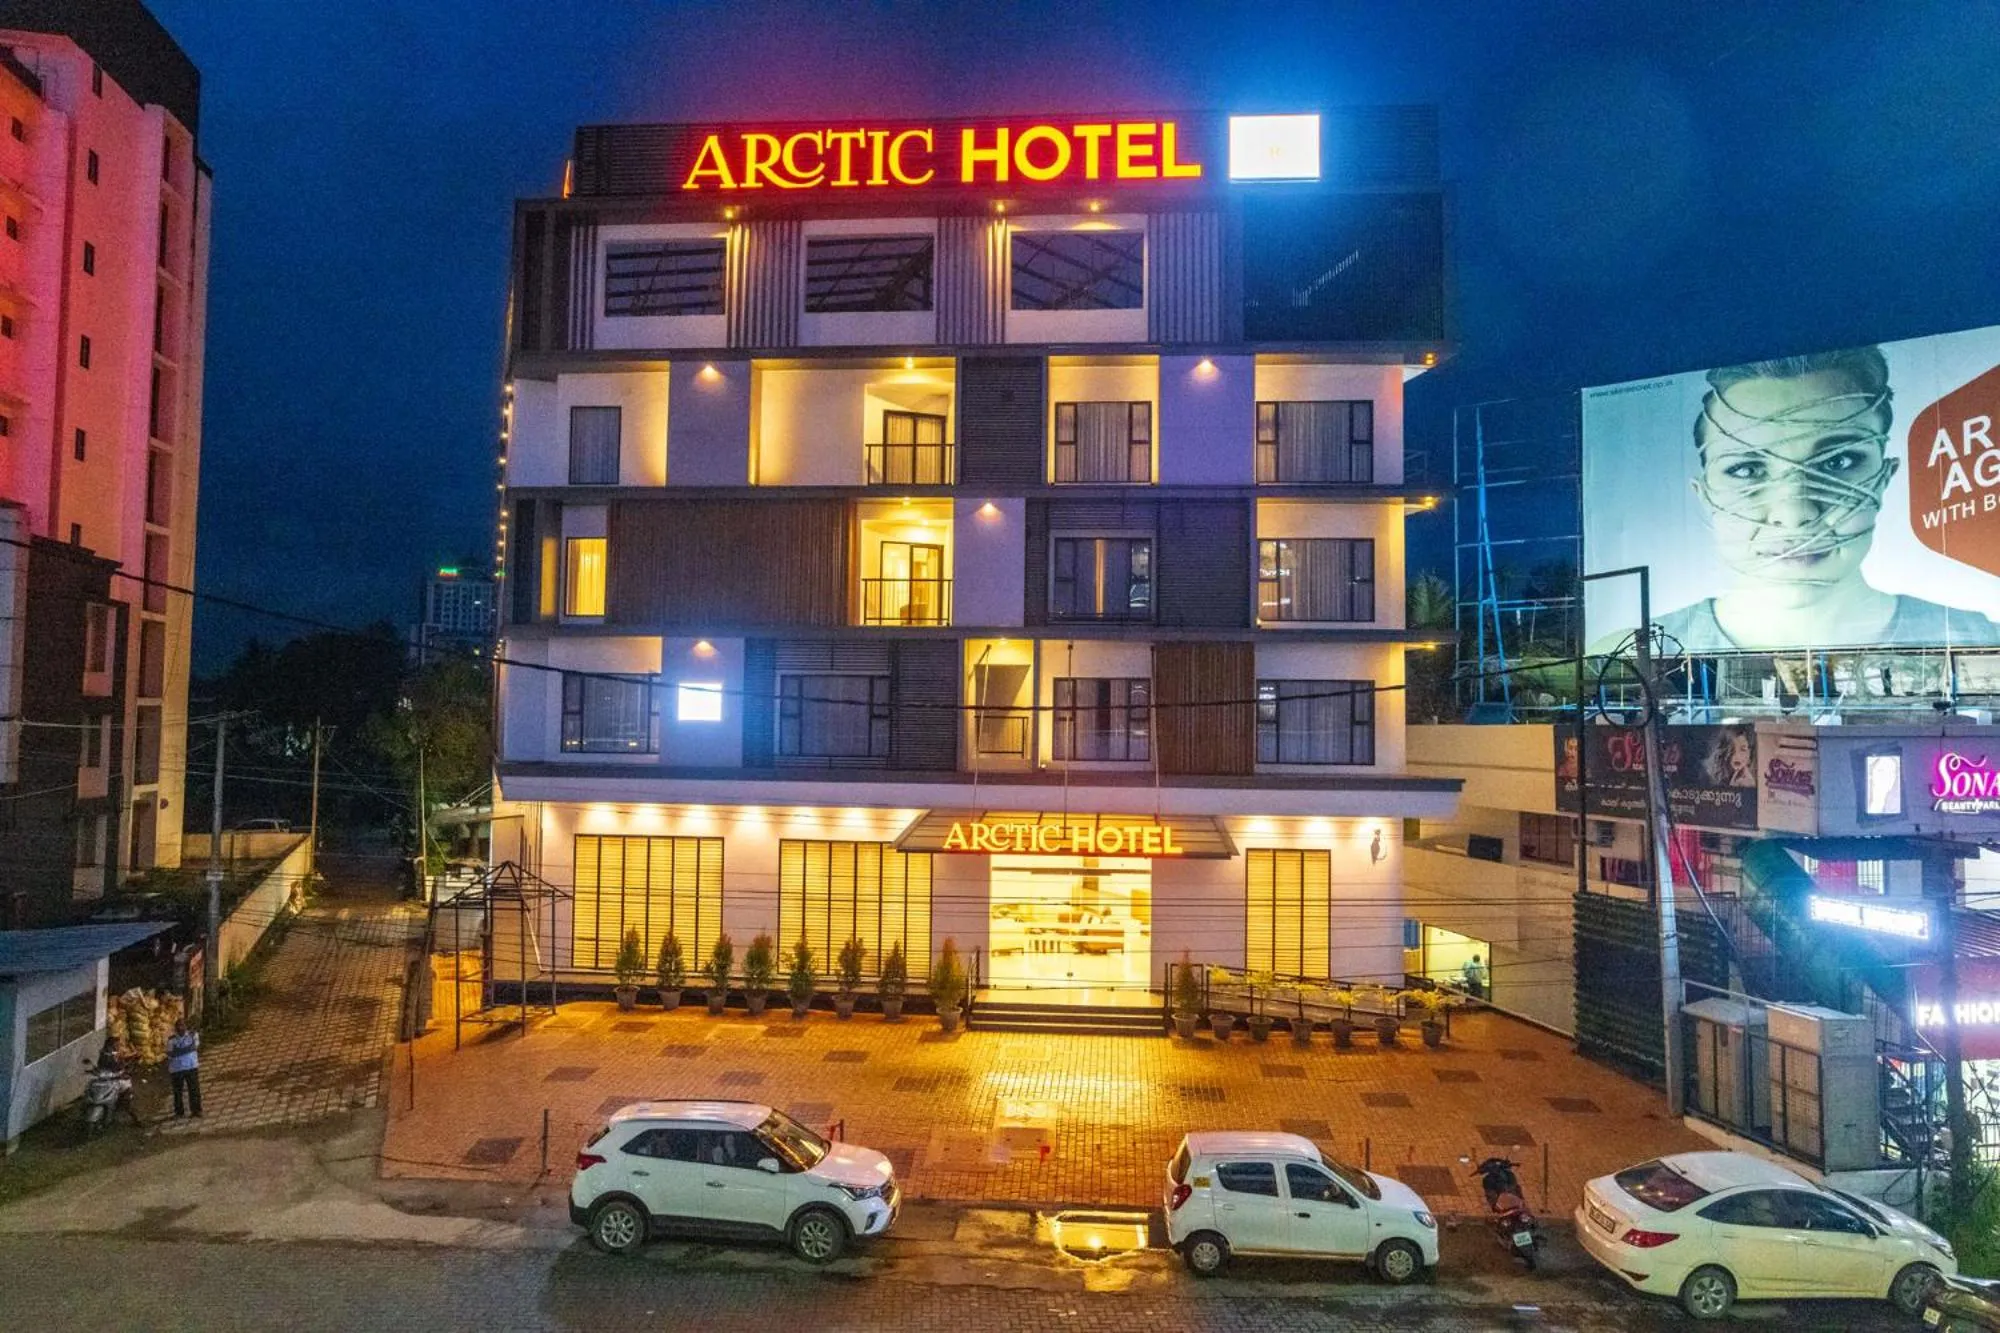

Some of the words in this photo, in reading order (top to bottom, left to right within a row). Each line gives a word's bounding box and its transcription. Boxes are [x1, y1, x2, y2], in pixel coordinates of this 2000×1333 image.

[682, 128, 934, 189] ARCTIC
[961, 123, 1201, 182] HOTEL
[1927, 415, 1994, 468] AR
[1922, 499, 1976, 529] WITH
[1984, 493, 2000, 512] B
[943, 822, 1060, 852] ARCTIC
[1072, 826, 1183, 854] HOTEL
